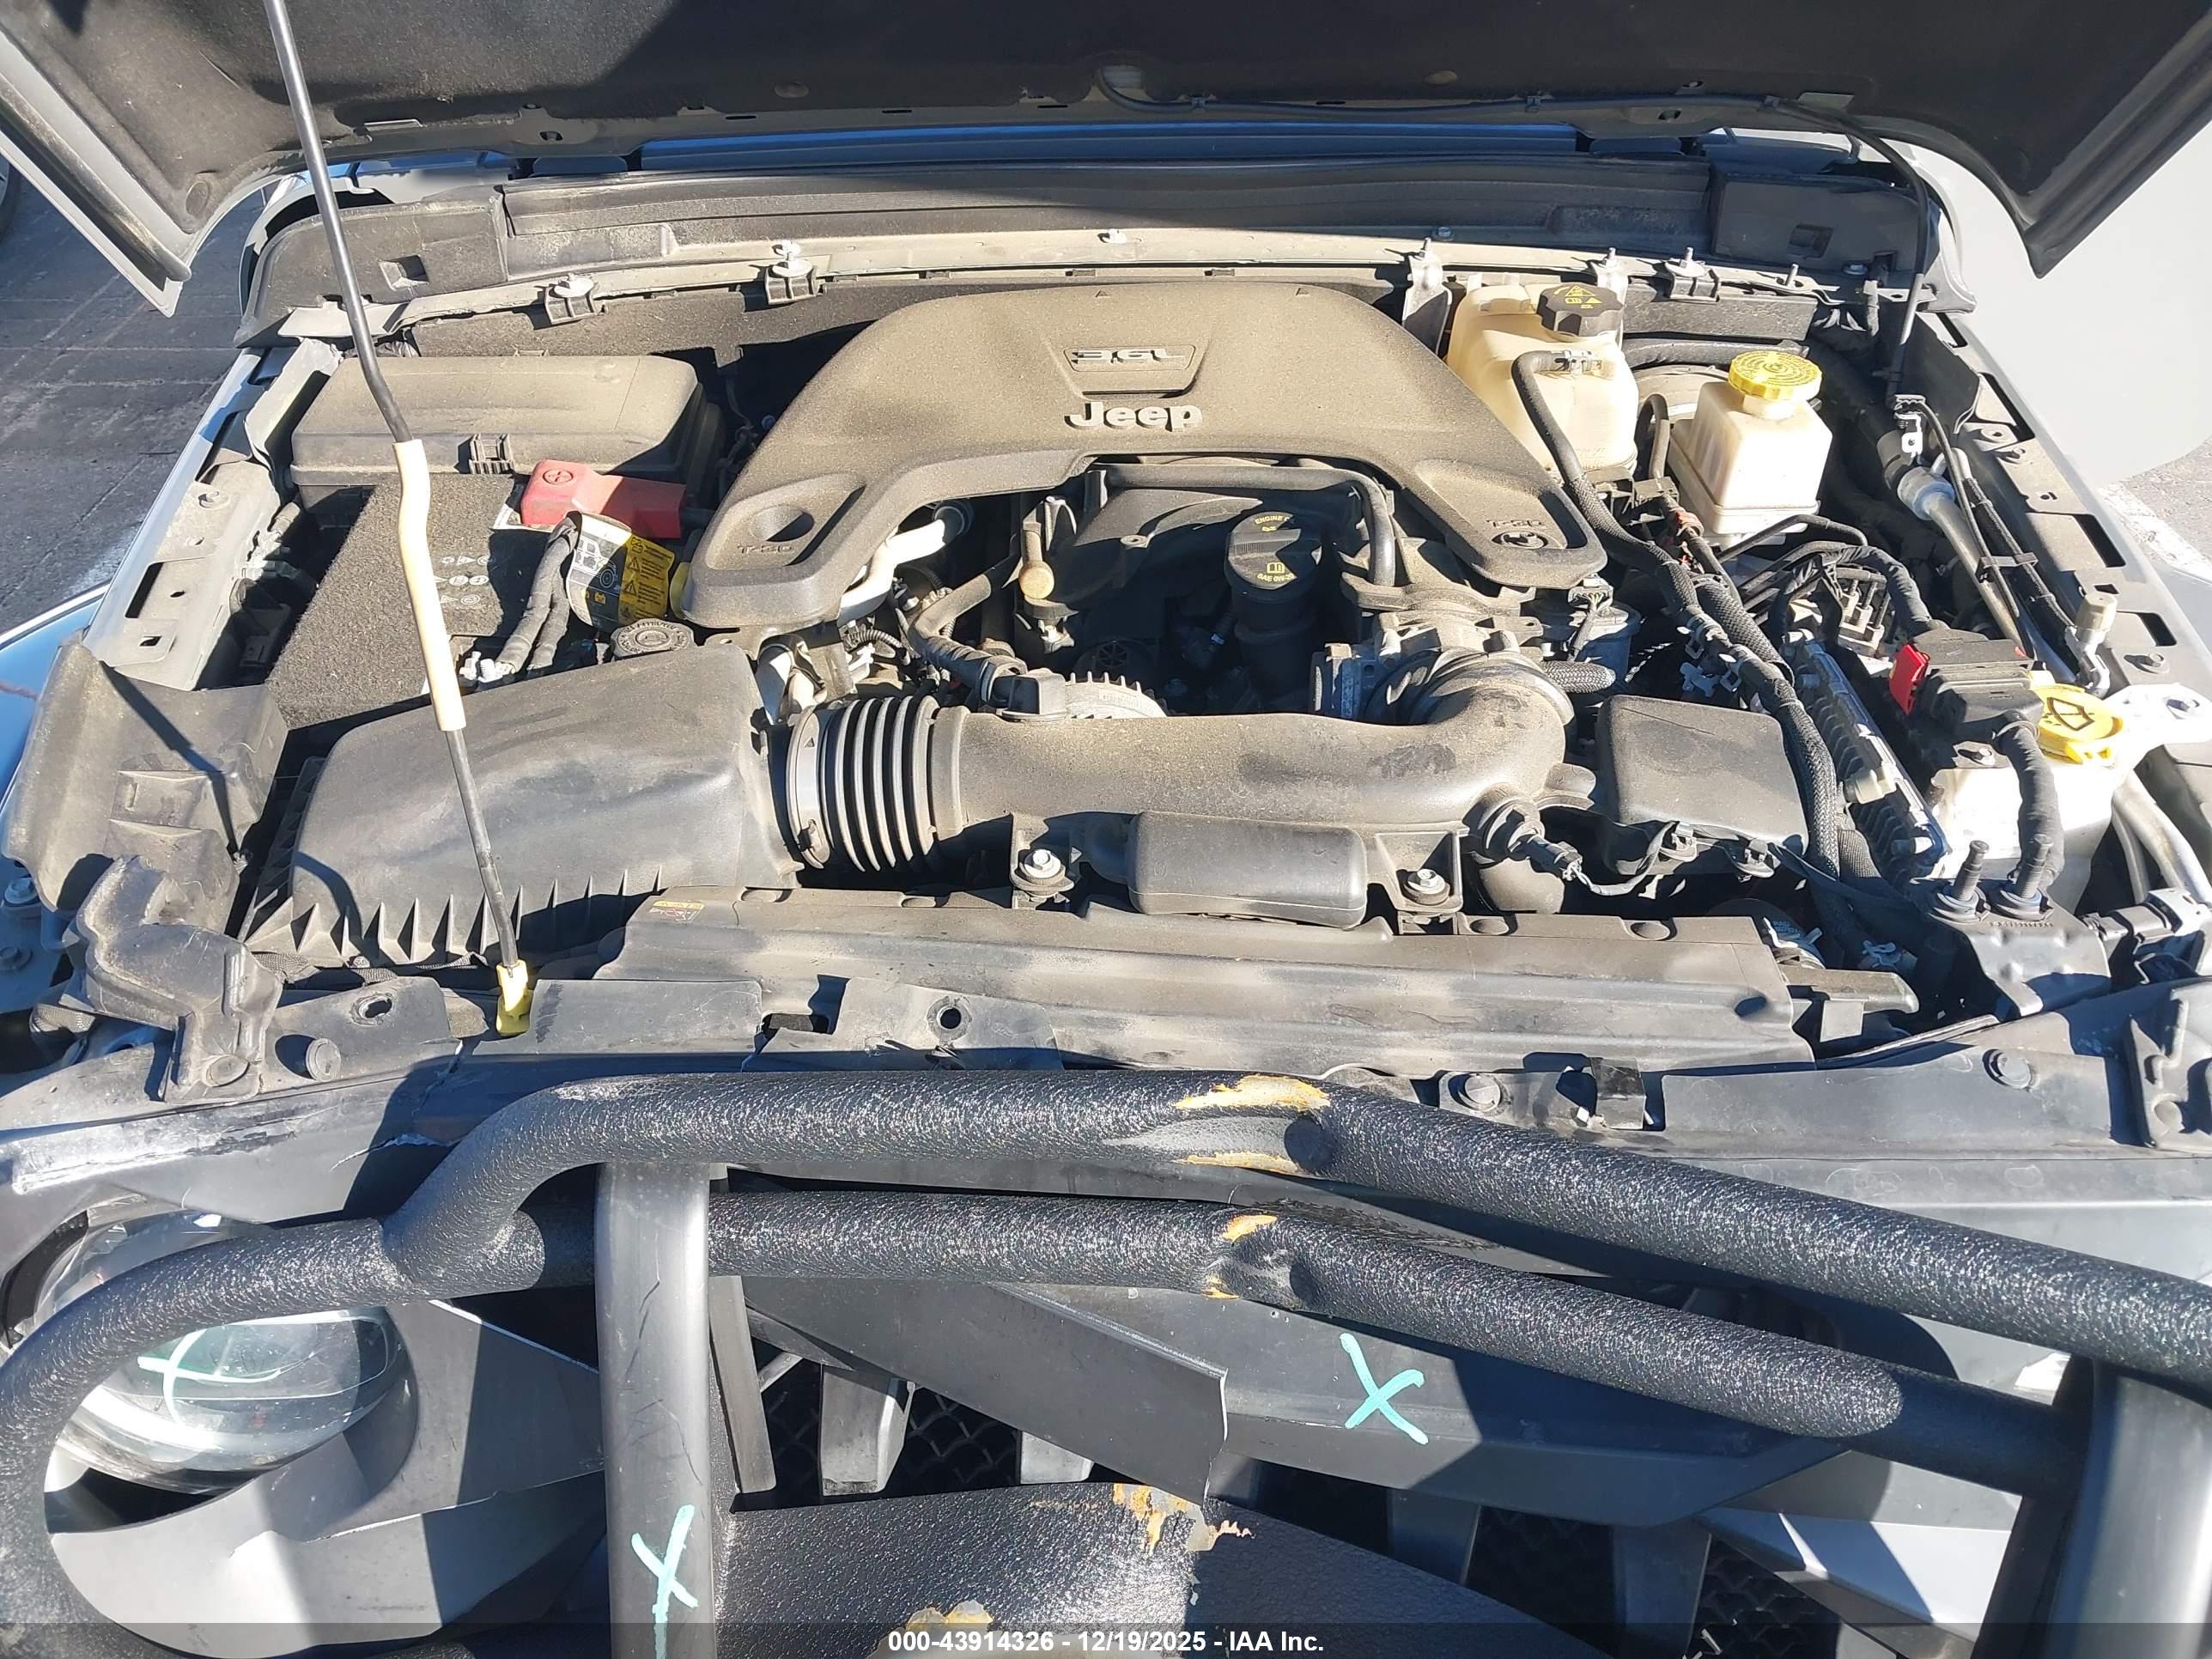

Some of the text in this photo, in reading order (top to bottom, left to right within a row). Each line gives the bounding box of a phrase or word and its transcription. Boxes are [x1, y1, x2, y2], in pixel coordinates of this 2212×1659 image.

[1064, 401, 1203, 432] Jeep
[1255, 515, 1284, 525] ENGINE
[1257, 573, 1273, 582] SAE
